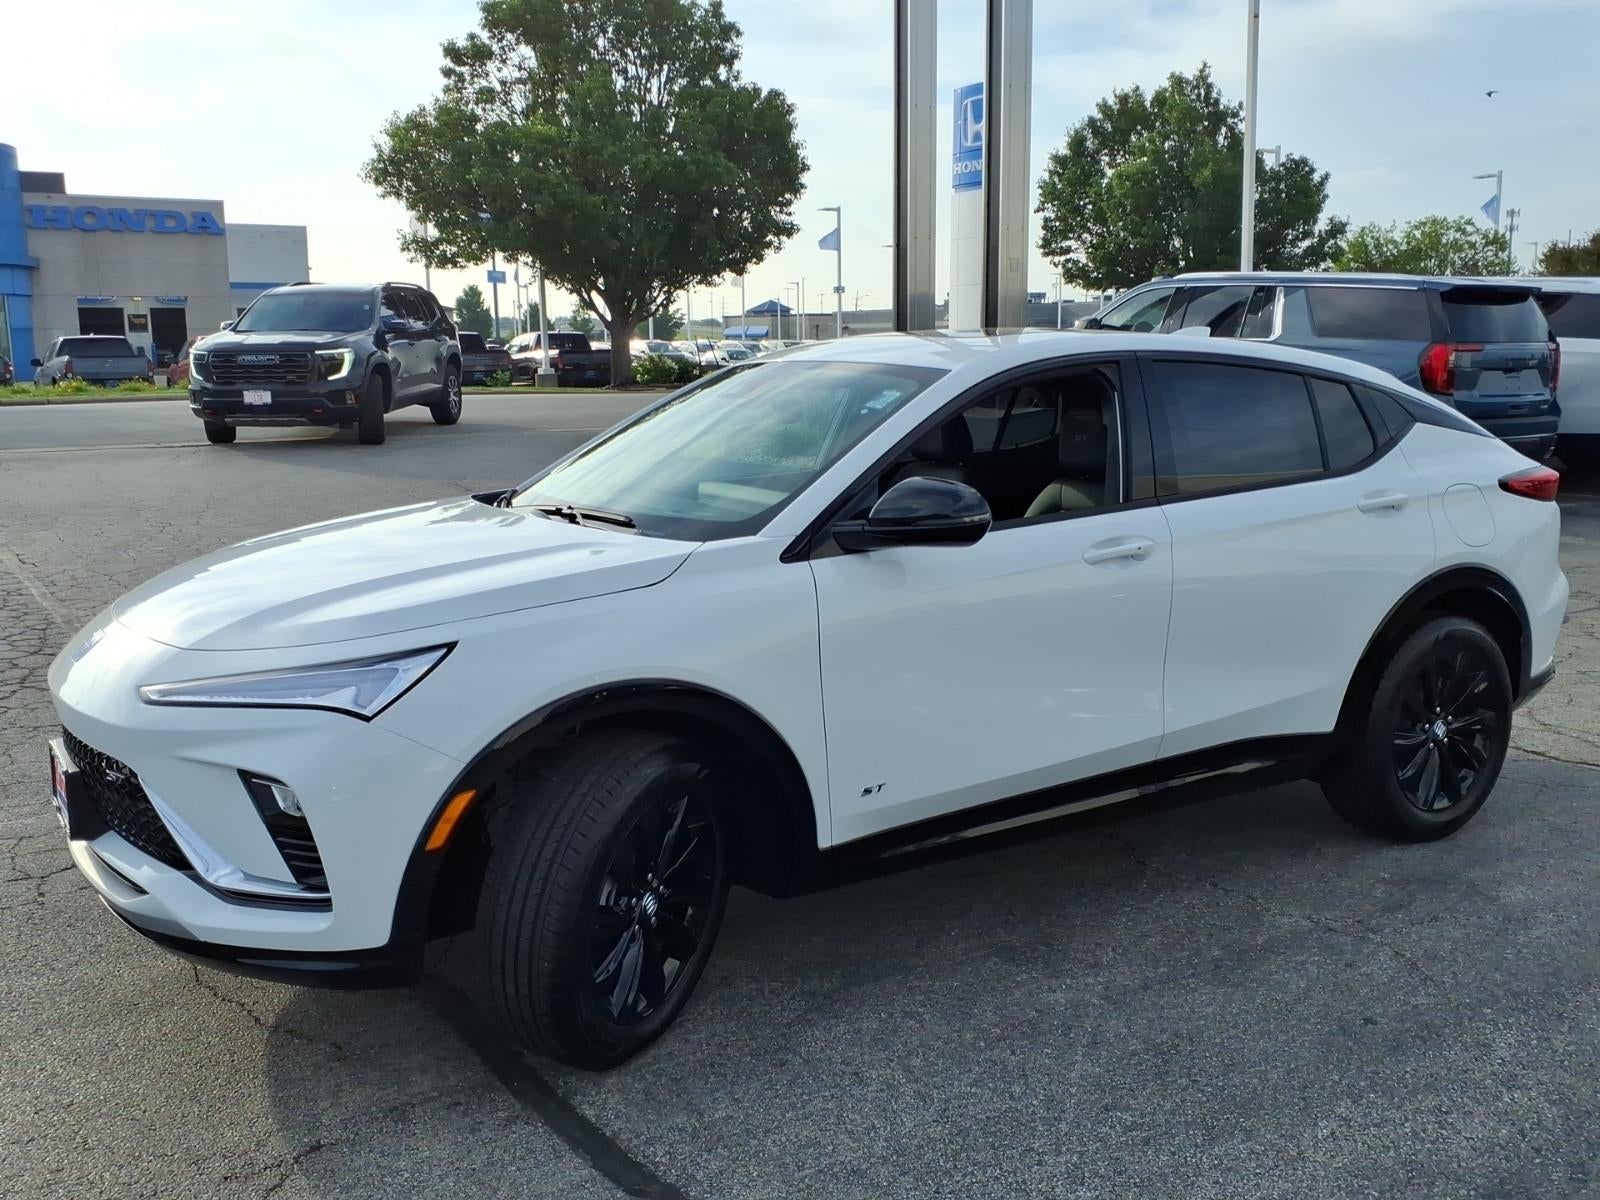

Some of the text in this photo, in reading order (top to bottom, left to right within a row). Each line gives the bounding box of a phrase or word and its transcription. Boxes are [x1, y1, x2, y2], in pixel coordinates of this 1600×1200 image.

[953, 160, 983, 174] HON
[26, 204, 225, 235] HONDA
[860, 782, 887, 797] ST
